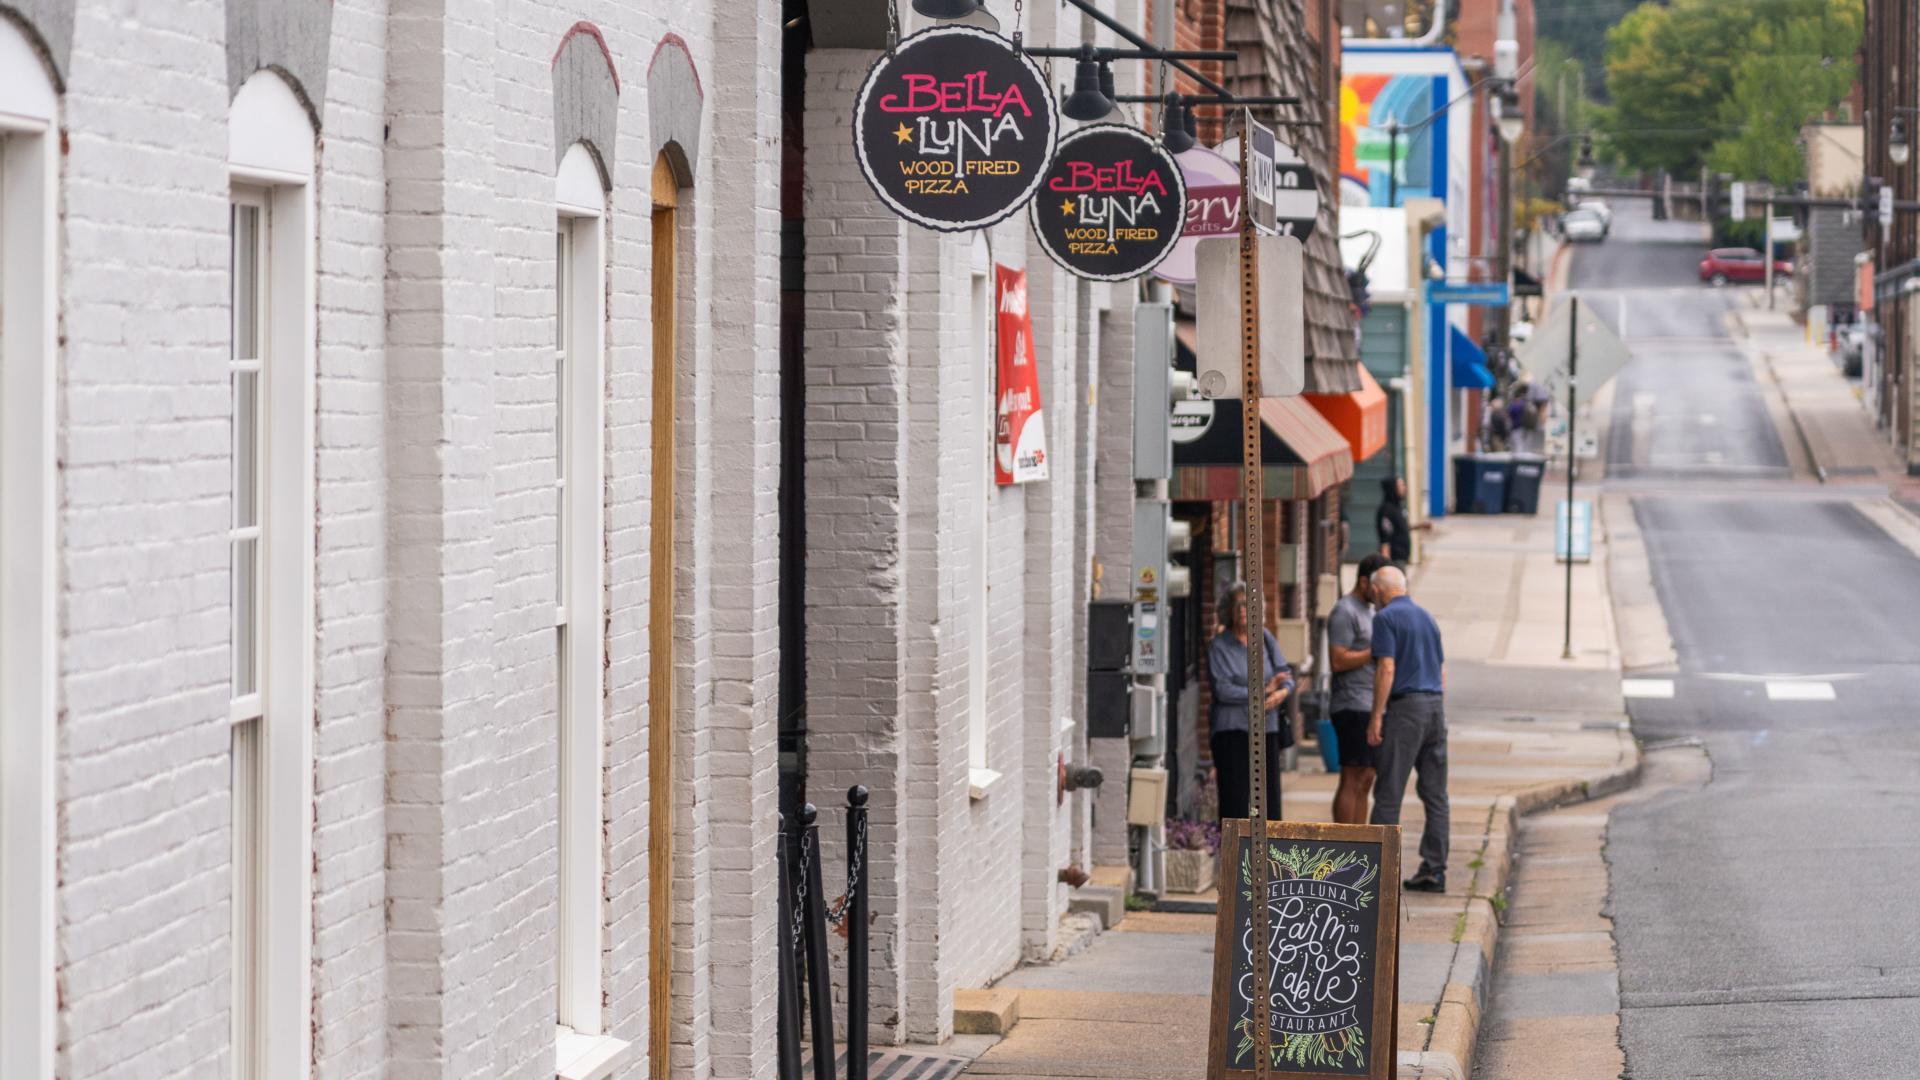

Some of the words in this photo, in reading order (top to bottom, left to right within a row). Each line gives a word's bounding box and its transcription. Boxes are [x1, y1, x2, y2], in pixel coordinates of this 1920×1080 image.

[880, 71, 1032, 117] BELLA
[916, 112, 1024, 178] LUNA
[899, 161, 954, 175] WOOD
[966, 161, 1020, 175] FIRED
[1257, 156, 1272, 199] WAY
[905, 180, 969, 194] PIZZA
[1050, 160, 1168, 196] BELLA
[1077, 192, 1161, 242] LUNA
[1187, 196, 1240, 231] ery
[1064, 228, 1106, 240] WOOD
[1116, 228, 1158, 240] FIRED
[1068, 243, 1118, 254] PIZZA
[1310, 883, 1347, 902] LUNA
[1349, 924, 1360, 933] TO
[1270, 1012, 1348, 1031] STAURANT
